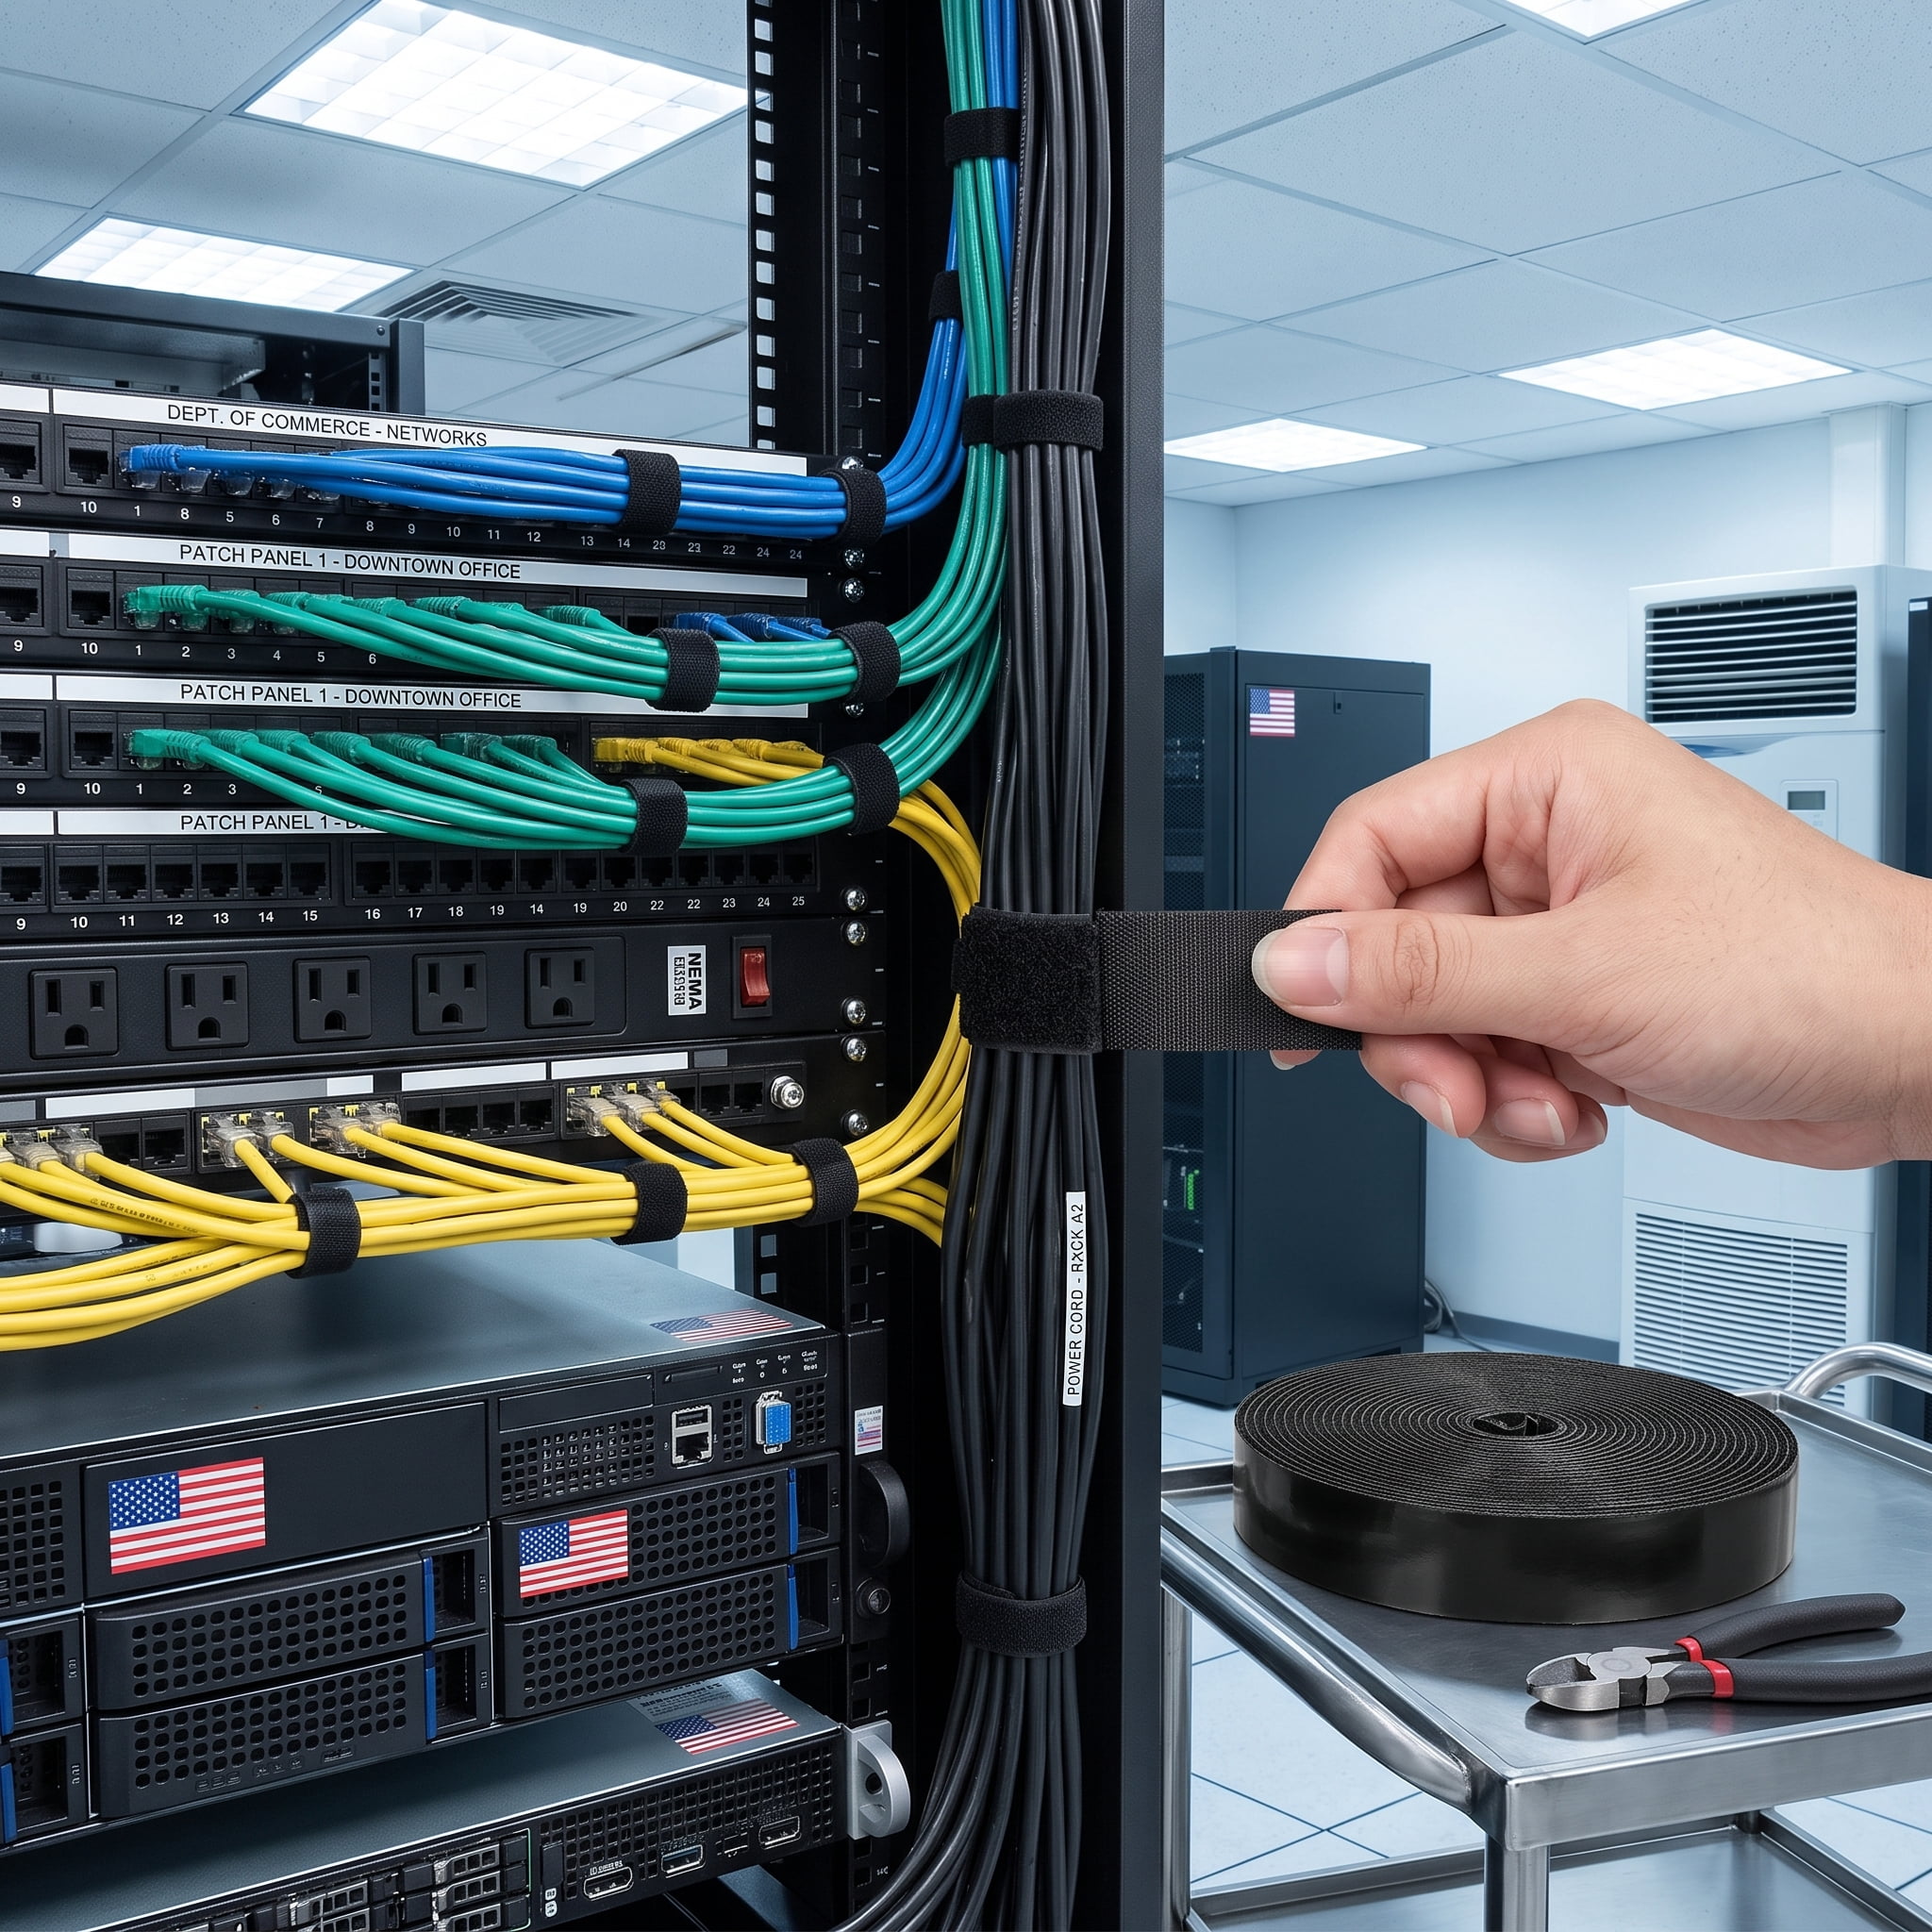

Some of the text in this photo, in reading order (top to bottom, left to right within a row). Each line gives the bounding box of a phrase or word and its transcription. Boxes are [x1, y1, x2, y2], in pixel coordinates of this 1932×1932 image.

[168, 404, 225, 425] DEPT.
[229, 409, 256, 426] OF
[261, 412, 371, 437] COMMERCE
[387, 424, 487, 448] NETWORKS
[11, 495, 22, 508] 9
[80, 501, 97, 514] 10
[134, 505, 141, 517] 1
[180, 508, 190, 520] 8
[225, 510, 234, 523] 5
[272, 513, 280, 525] 6
[316, 517, 324, 529] 7
[366, 520, 375, 532] 8
[408, 523, 416, 535] 9
[446, 526, 461, 538] 10
[488, 529, 500, 541] 11
[526, 531, 541, 542] 12
[580, 536, 594, 546] 13
[618, 538, 631, 548] 14
[723, 544, 736, 556] 22
[757, 546, 770, 558] 24
[790, 549, 802, 559] 24
[180, 544, 244, 563] PATCH
[251, 548, 313, 567] PANEL
[319, 552, 325, 568] 1
[344, 553, 454, 575] DOWNTOWN
[458, 560, 521, 579] OFFICE
[13, 640, 376, 665] 9 10 1 2 3 4 5 6
[180, 683, 245, 701] PATCH
[252, 686, 313, 703] PANEL
[319, 688, 326, 703] 1
[345, 688, 454, 707] DOWNTOWN
[458, 691, 522, 708] OFFICE
[16, 782, 26, 795] 9
[84, 782, 101, 795] 10
[136, 783, 142, 794] 1
[183, 783, 192, 795] 2
[228, 783, 237, 795] 3
[181, 814, 246, 830] PATCH
[252, 814, 314, 830] PANEL
[320, 814, 327, 830] 1
[16, 896, 805, 930] 9 10 11 12 13 14 15 16 17 18 19 14 19 20 22 22 23 24 25
[688, 952, 703, 1010] NEMA
[1071, 1204, 1084, 1224] A2
[1070, 1229, 1084, 1273] RXCK
[1069, 1290, 1084, 1335] CORD
[1067, 1340, 1082, 1395] POWER
